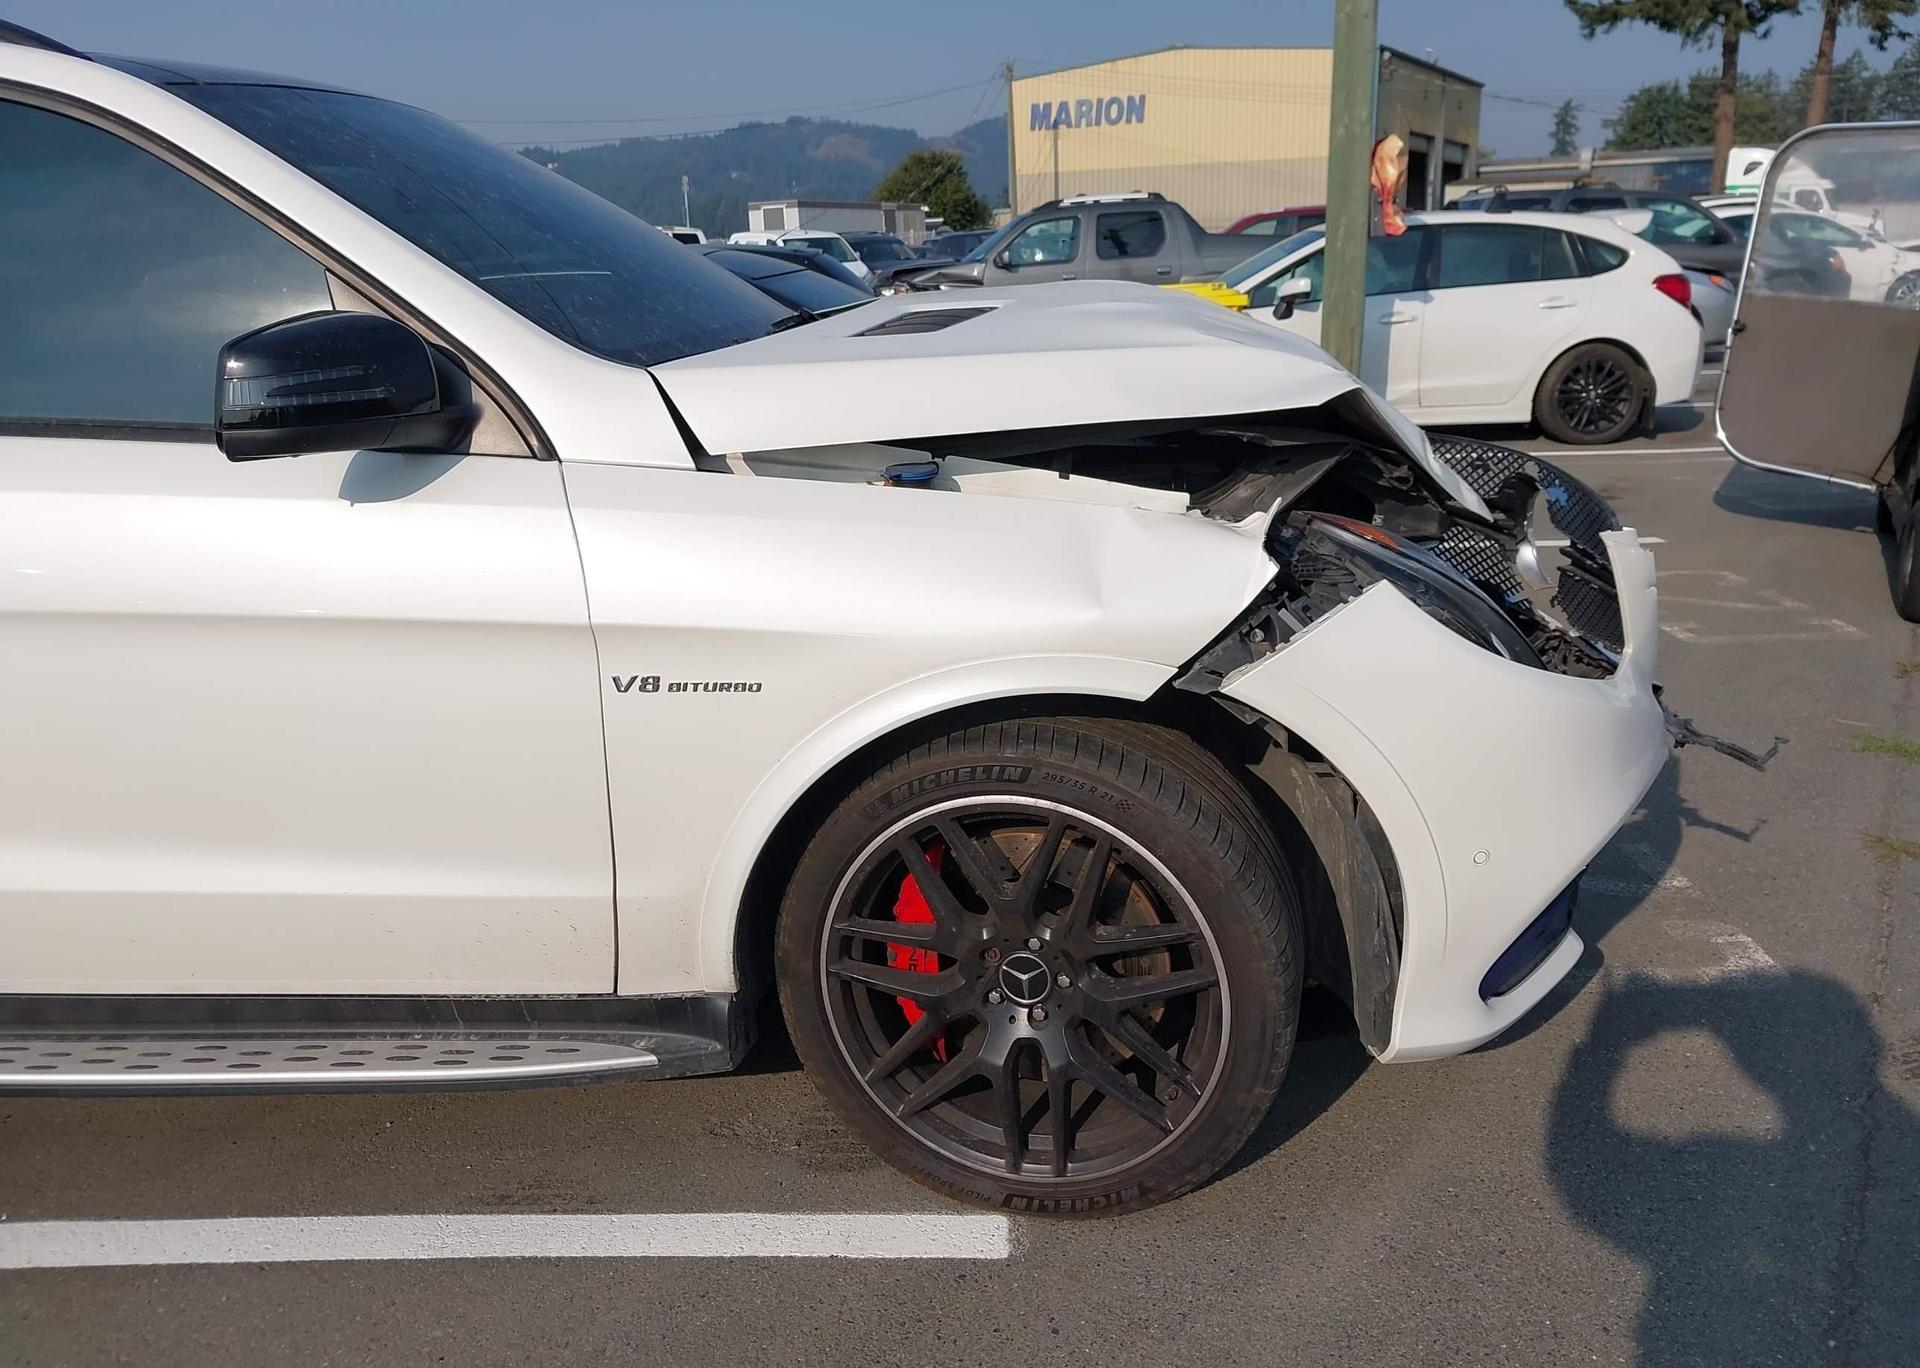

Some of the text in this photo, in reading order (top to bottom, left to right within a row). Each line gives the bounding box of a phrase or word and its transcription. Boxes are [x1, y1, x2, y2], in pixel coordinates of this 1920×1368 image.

[1030, 94, 1146, 131] MARION
[611, 675, 763, 693] V8 BITURBO
[890, 766, 1024, 803] MICHELIN
[1042, 772, 1114, 801] 295/35 R 21
[961, 1186, 992, 1202] PILOT
[1009, 1185, 1140, 1213] MICHELIN
